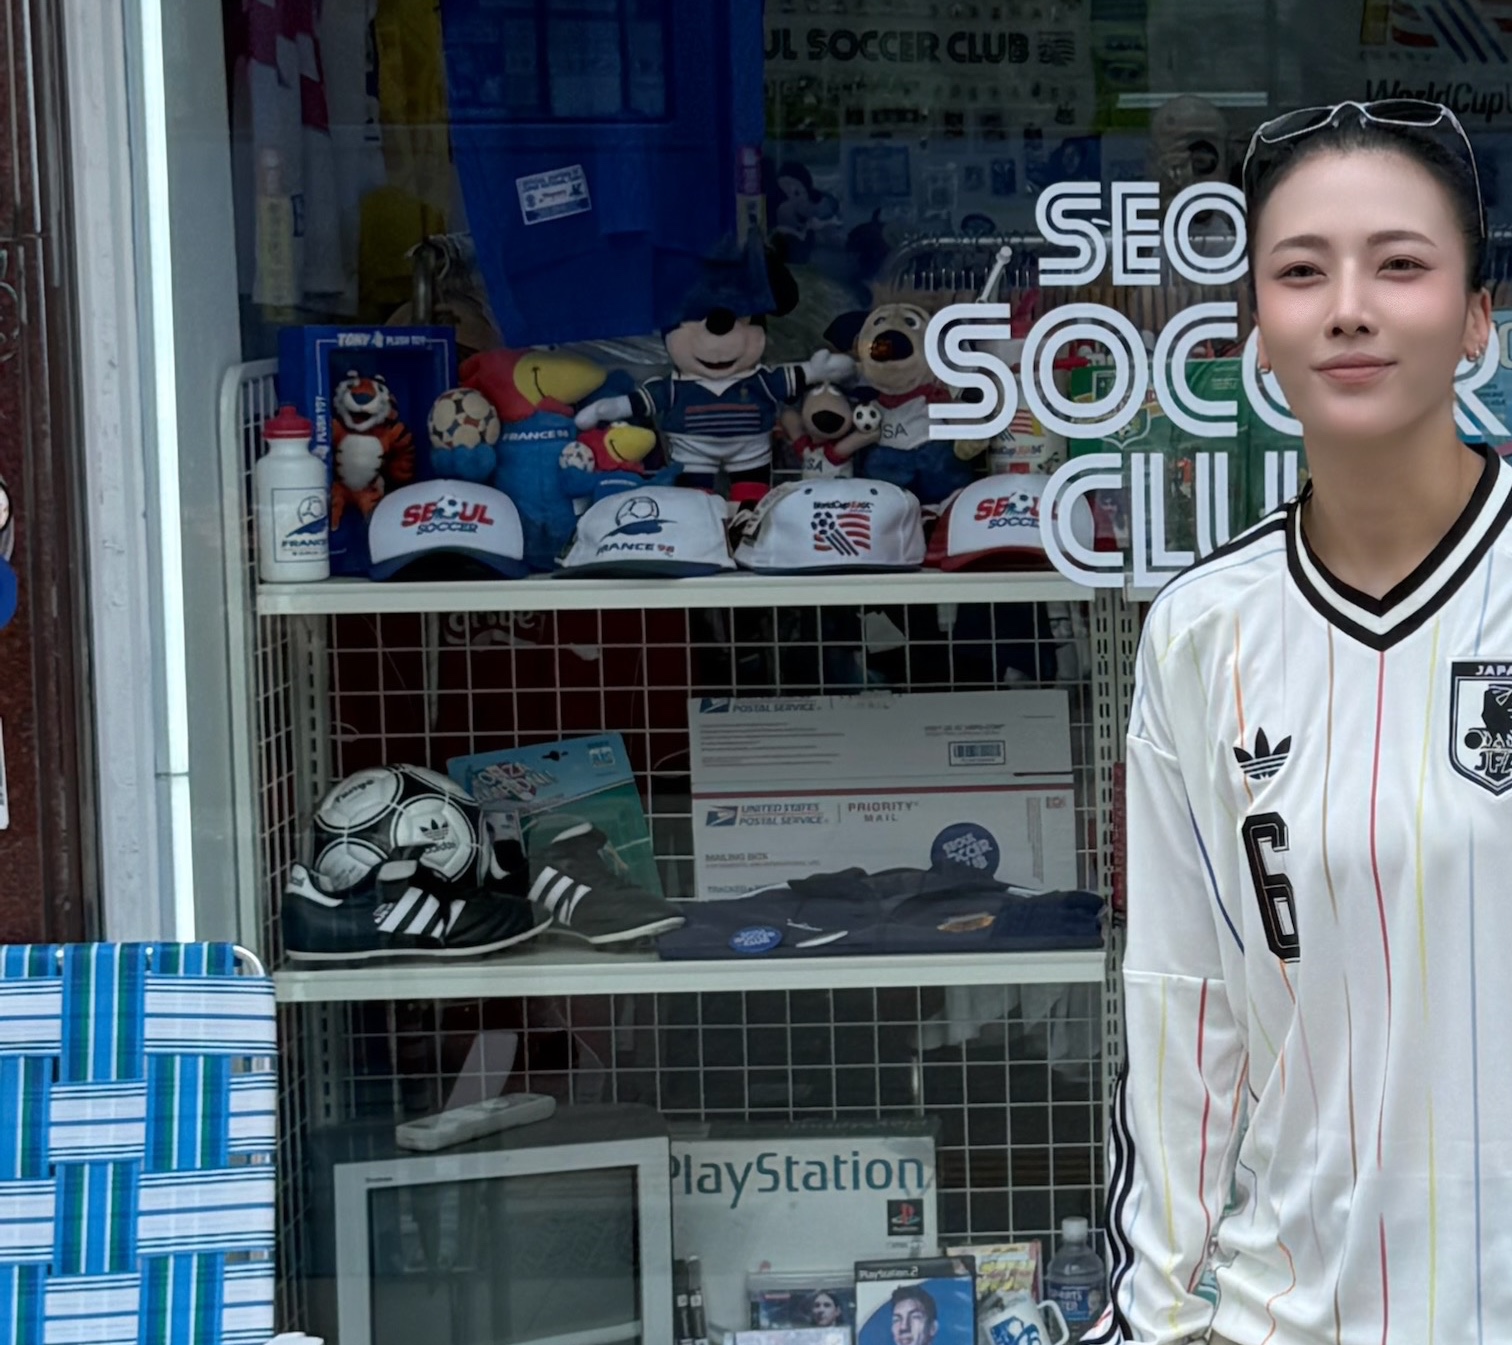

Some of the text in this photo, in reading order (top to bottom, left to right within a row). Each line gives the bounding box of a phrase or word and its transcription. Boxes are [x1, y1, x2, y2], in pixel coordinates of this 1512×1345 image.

[806, 28, 942, 63] SOCCER
[946, 30, 1030, 65] CLUB
[1035, 181, 1250, 287] SEO
[923, 301, 1512, 441] SOCR
[501, 429, 556, 442] FRANCE
[881, 424, 909, 440] SA
[802, 459, 823, 473] SA
[987, 517, 1041, 529] SOCCE
[1039, 450, 1299, 589] CLU
[416, 523, 479, 536] SOCCER
[281, 538, 328, 549] FRANC
[848, 801, 913, 812] PRIORITY
[739, 816, 823, 826] POSTAL SERVICE
[863, 813, 899, 823] MAIL
[1241, 811, 1301, 963] 6
